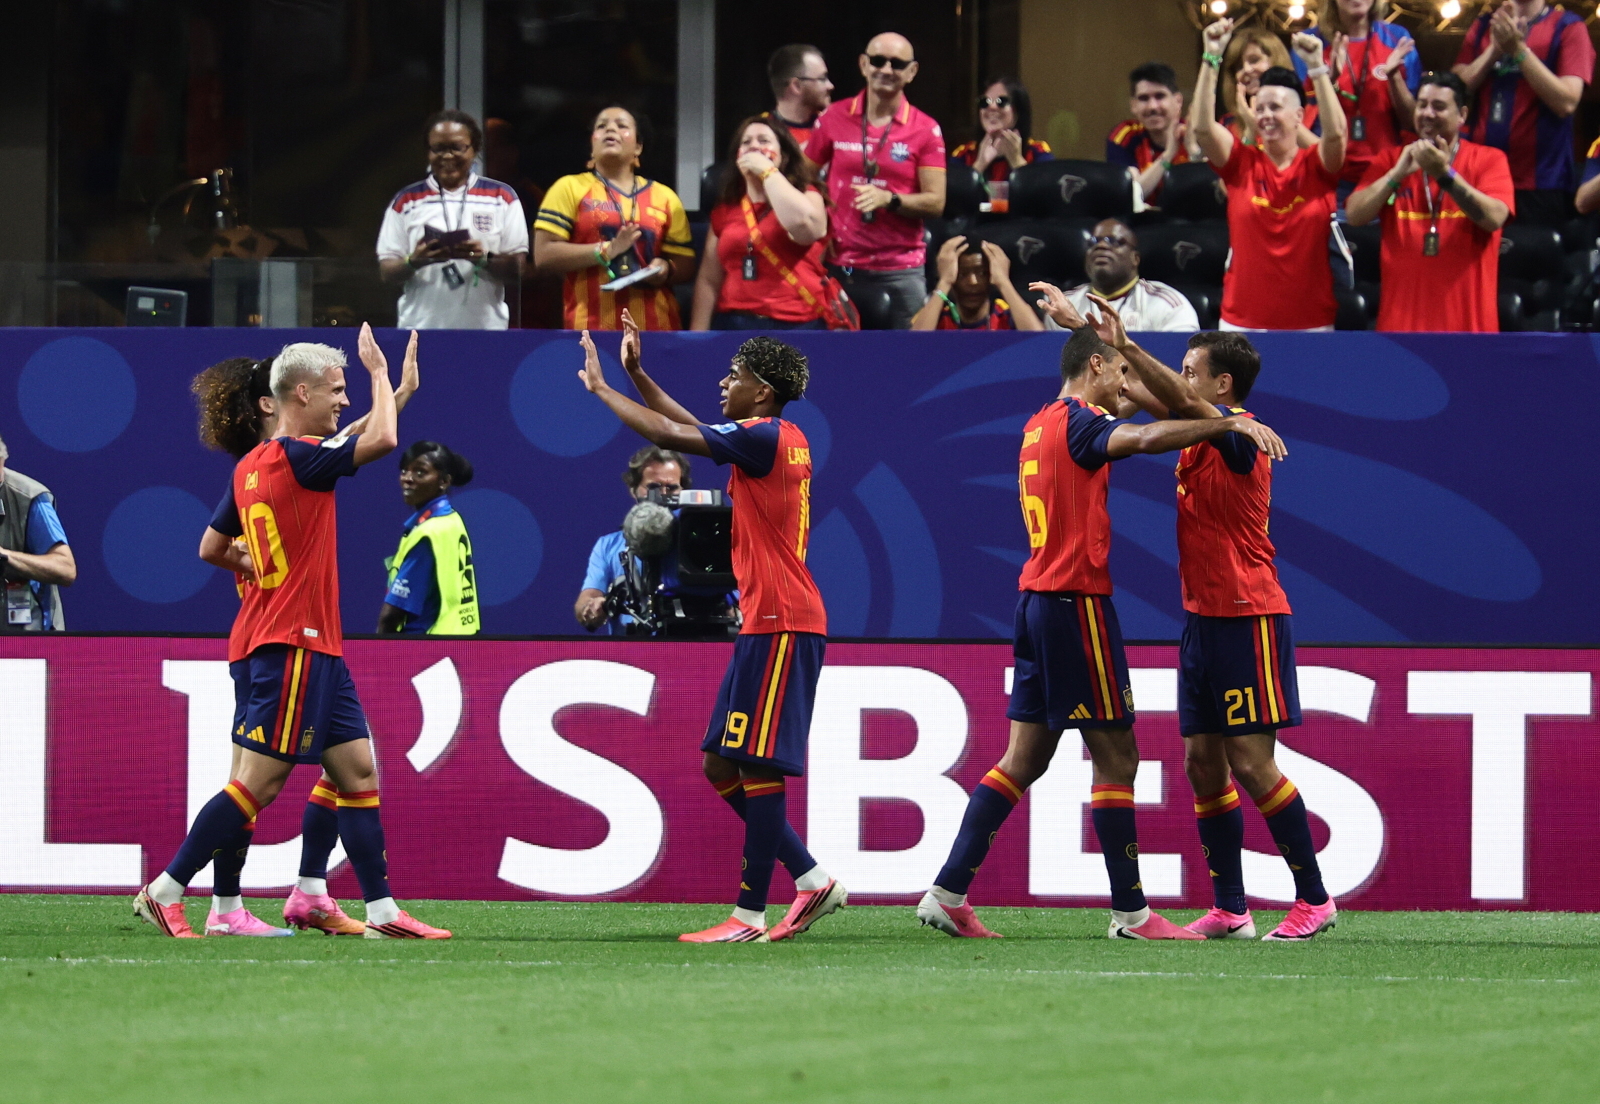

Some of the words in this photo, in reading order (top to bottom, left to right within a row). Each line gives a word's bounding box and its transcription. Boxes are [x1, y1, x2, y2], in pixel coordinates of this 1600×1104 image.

[1018, 460, 1047, 548] 6
[721, 710, 749, 748] 19
[1224, 686, 1257, 726] 21
[808, 664, 1592, 902] BEST
